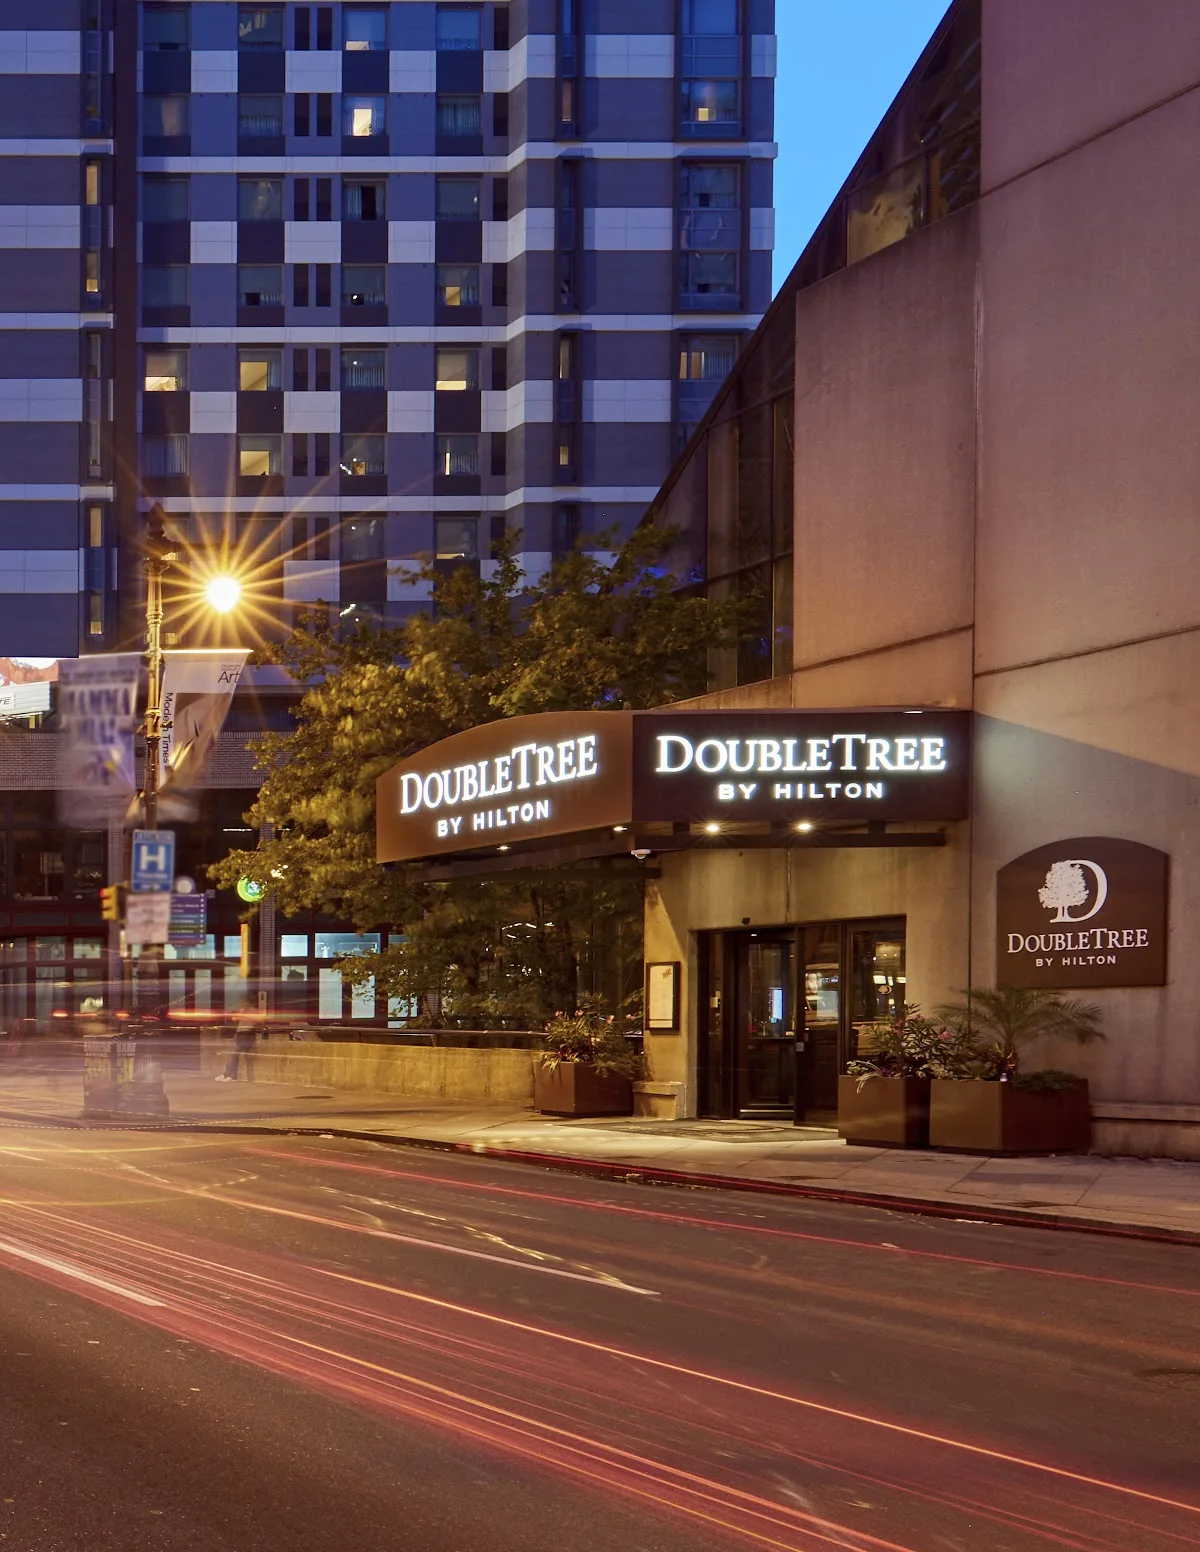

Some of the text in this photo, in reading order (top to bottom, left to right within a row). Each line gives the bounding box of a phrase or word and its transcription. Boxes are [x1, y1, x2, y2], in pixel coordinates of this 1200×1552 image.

[217, 671, 240, 683] Art
[162, 734, 170, 763] Times
[655, 733, 947, 773] DOUBLETREE
[399, 734, 599, 814] DOUBLETREE
[717, 782, 884, 800] BY HILTON
[437, 799, 550, 838] BY HILTON
[140, 845, 166, 871] H
[1007, 928, 1149, 953] DOUBLETREE
[1035, 955, 1116, 967] BY HILTON
